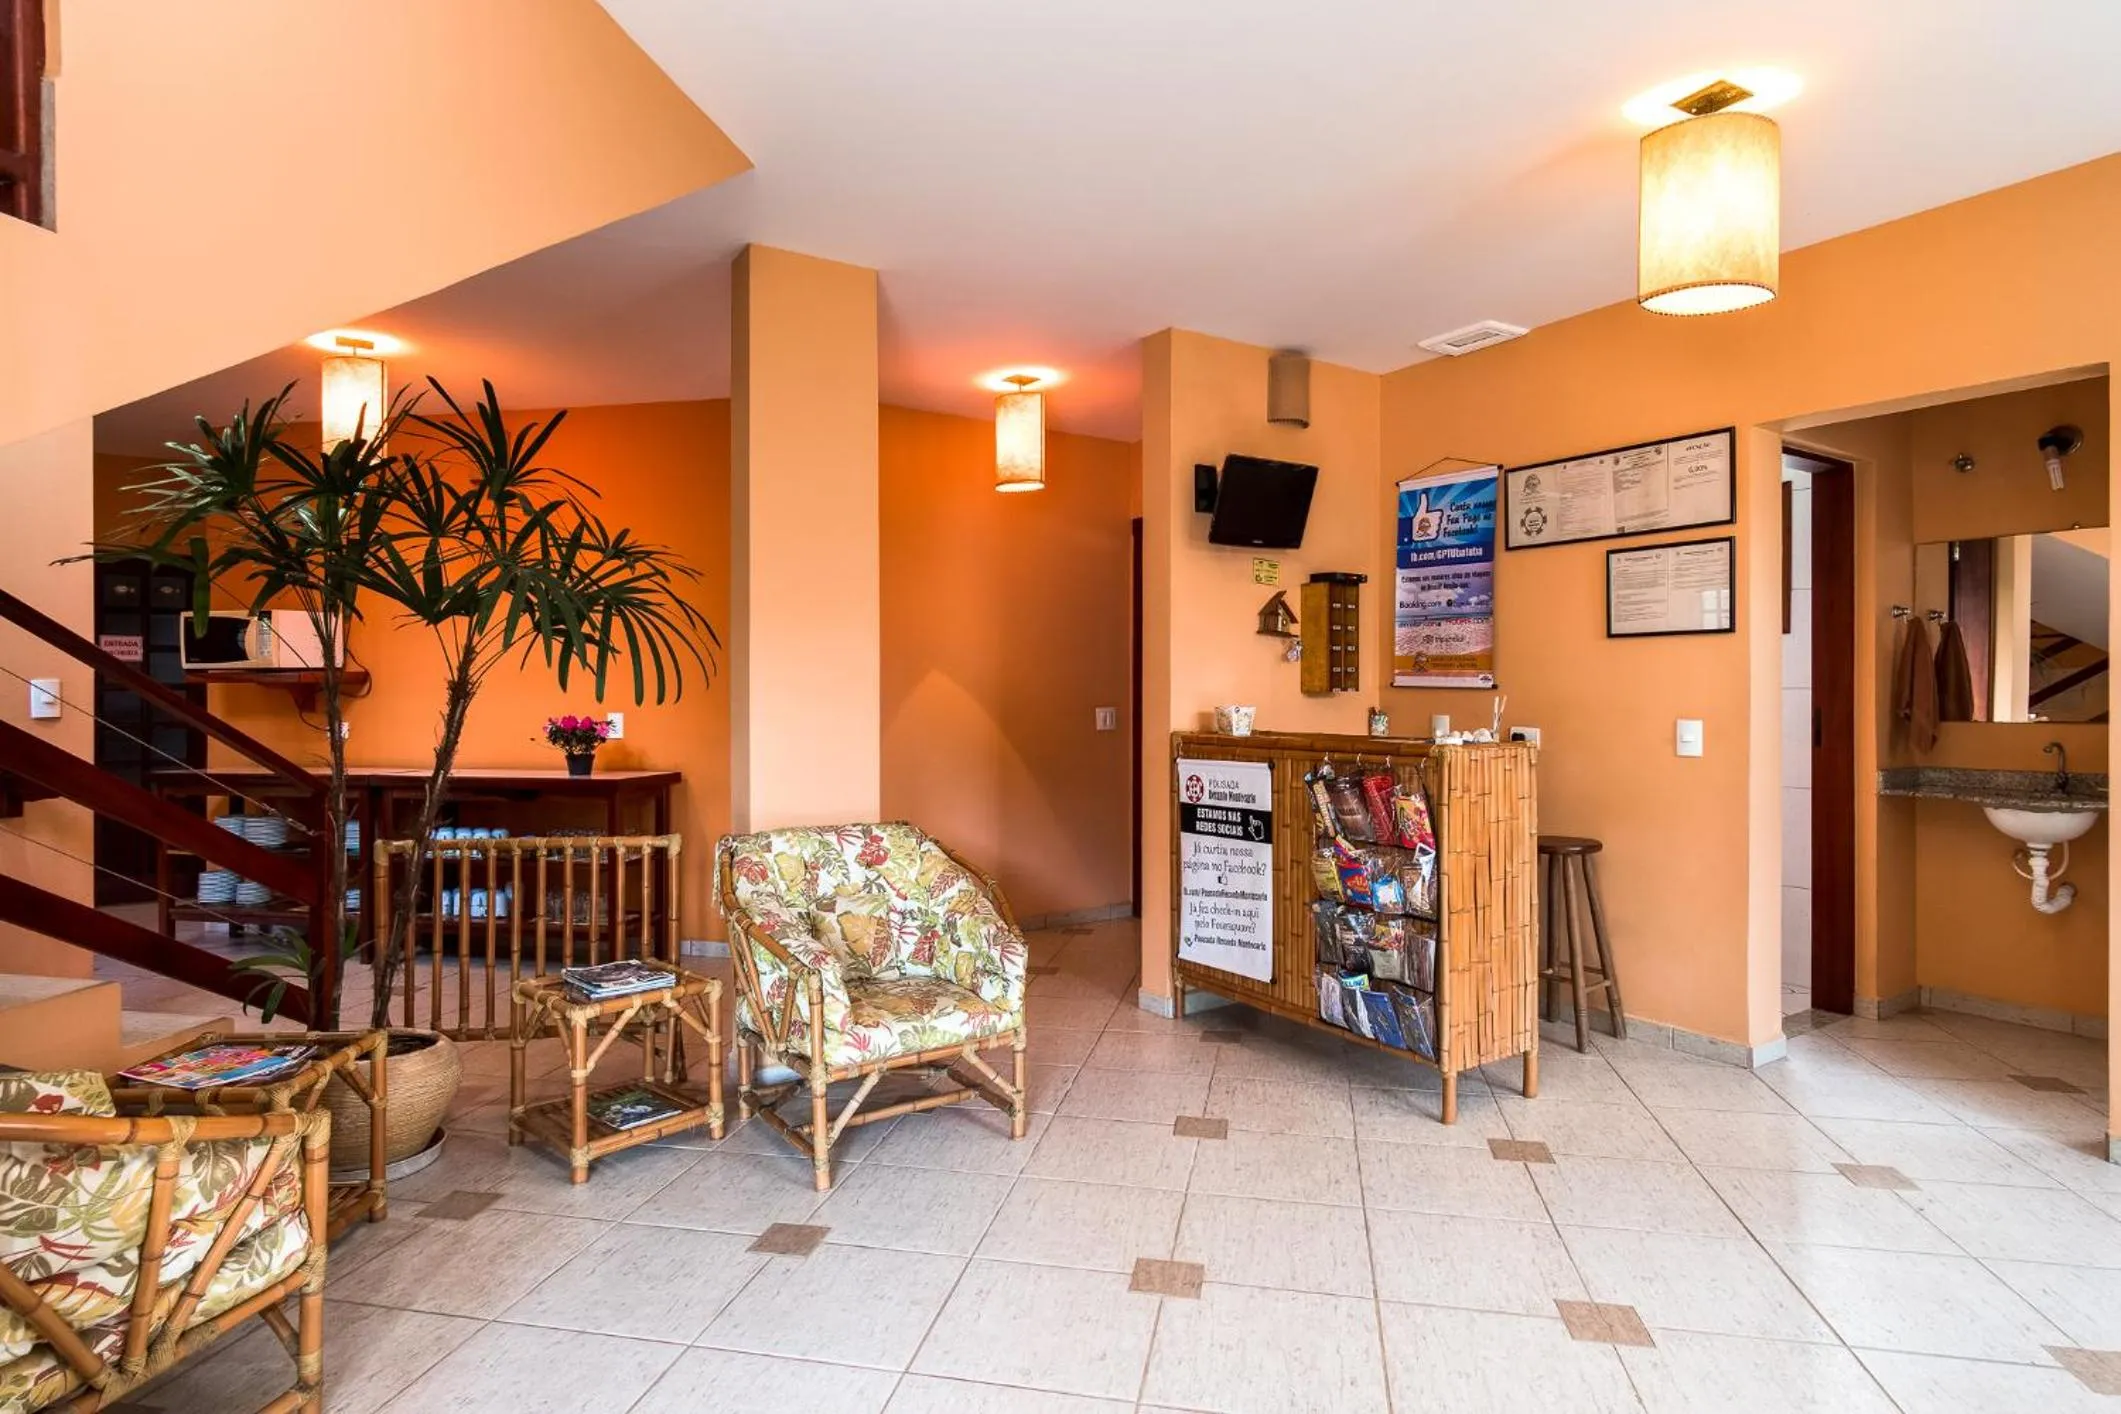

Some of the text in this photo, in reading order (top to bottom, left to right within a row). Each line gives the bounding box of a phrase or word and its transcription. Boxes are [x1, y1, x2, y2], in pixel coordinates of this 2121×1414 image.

[1399, 600, 1442, 609] Booking.com
[1208, 779, 1239, 789] POUSADA
[1197, 808, 1241, 822] ESTAMOS NAS
[1195, 821, 1243, 836] REDES SOCIAIS
[1230, 848, 1254, 857] nossa
[1211, 861, 1222, 871] no
[1223, 859, 1267, 876] Facebook?
[1209, 902, 1241, 917] check-in
[1211, 918, 1256, 935] Foursquare?
